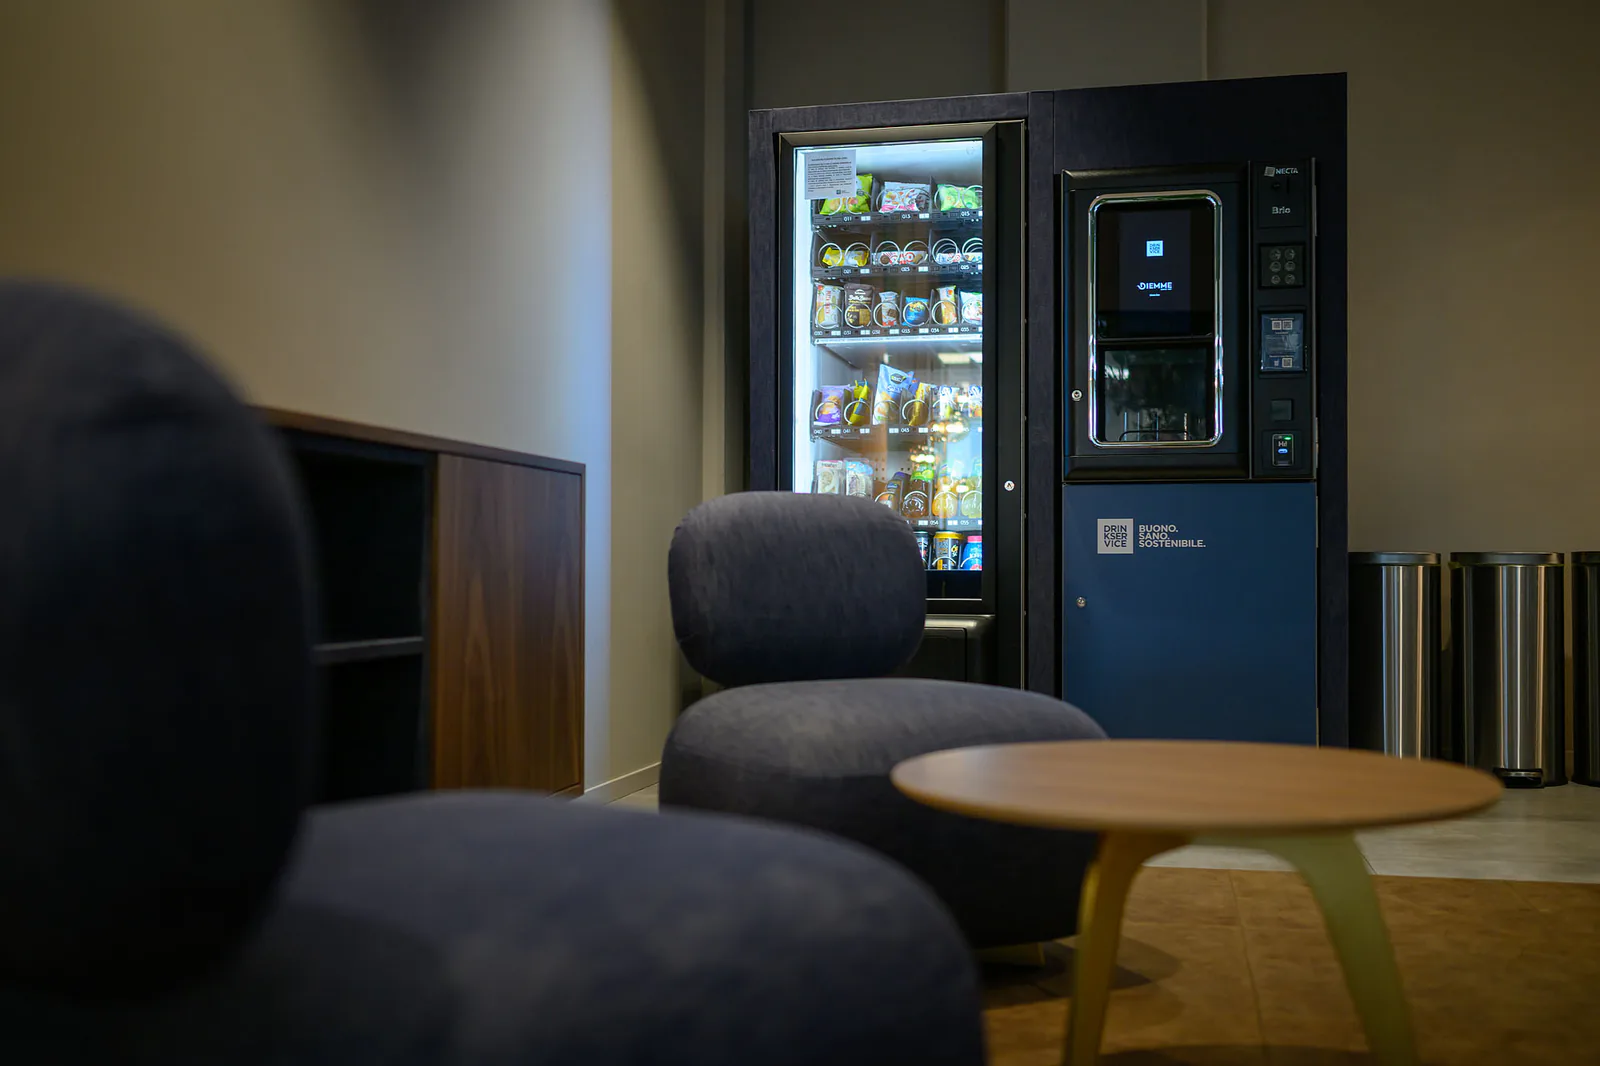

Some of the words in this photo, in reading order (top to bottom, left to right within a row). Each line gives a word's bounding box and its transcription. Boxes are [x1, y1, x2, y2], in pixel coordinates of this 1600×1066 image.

[1275, 167, 1299, 175] NECTA
[1271, 206, 1291, 215] Brio
[1137, 281, 1173, 290] DIEMME
[1103, 525, 1128, 533] DRIN
[1138, 524, 1179, 533] BUONO.
[1103, 532, 1128, 540] KSER
[1138, 532, 1170, 540] SANO.
[1104, 540, 1127, 548] VICE
[1138, 539, 1206, 548] SOSTENIBILE.
